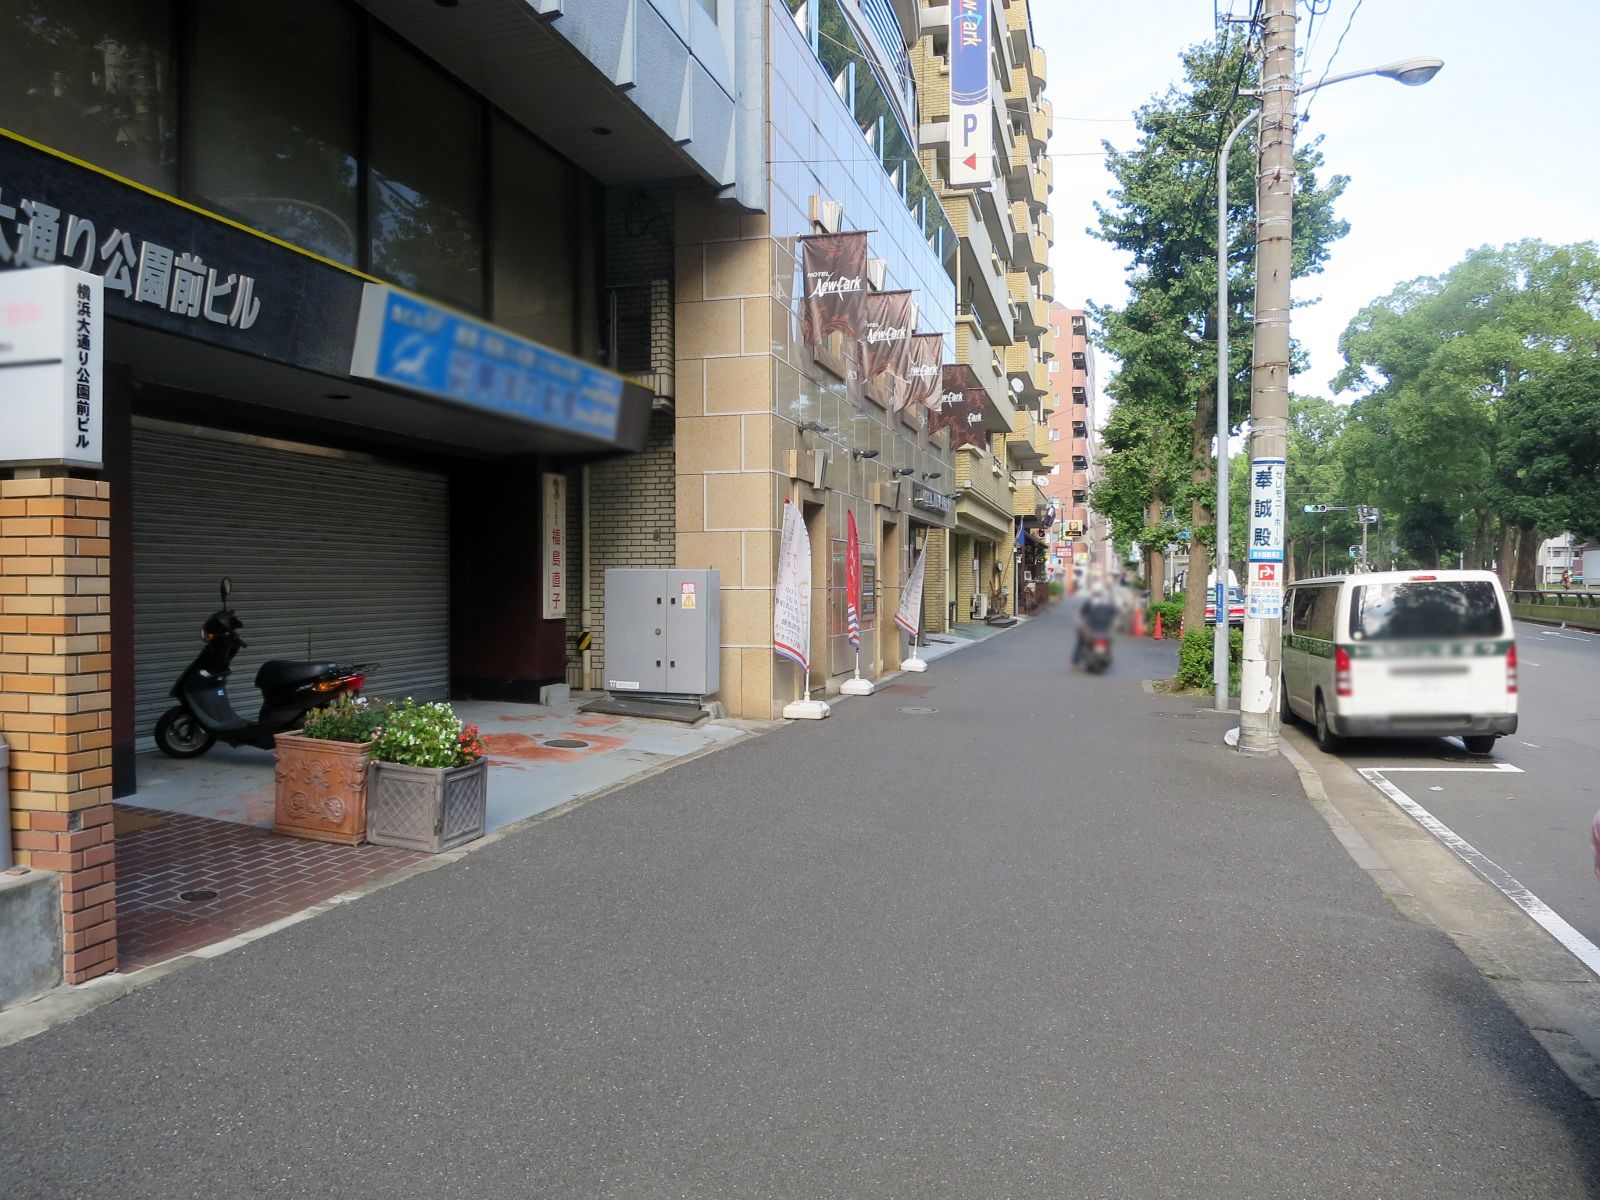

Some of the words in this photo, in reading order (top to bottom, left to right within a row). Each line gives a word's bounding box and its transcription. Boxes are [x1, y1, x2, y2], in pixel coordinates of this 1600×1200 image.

[963, 114, 977, 147] P
[76, 282, 91, 449] 横浜大通り公園前ビル
[1254, 470, 1273, 547] 奉誠殿
